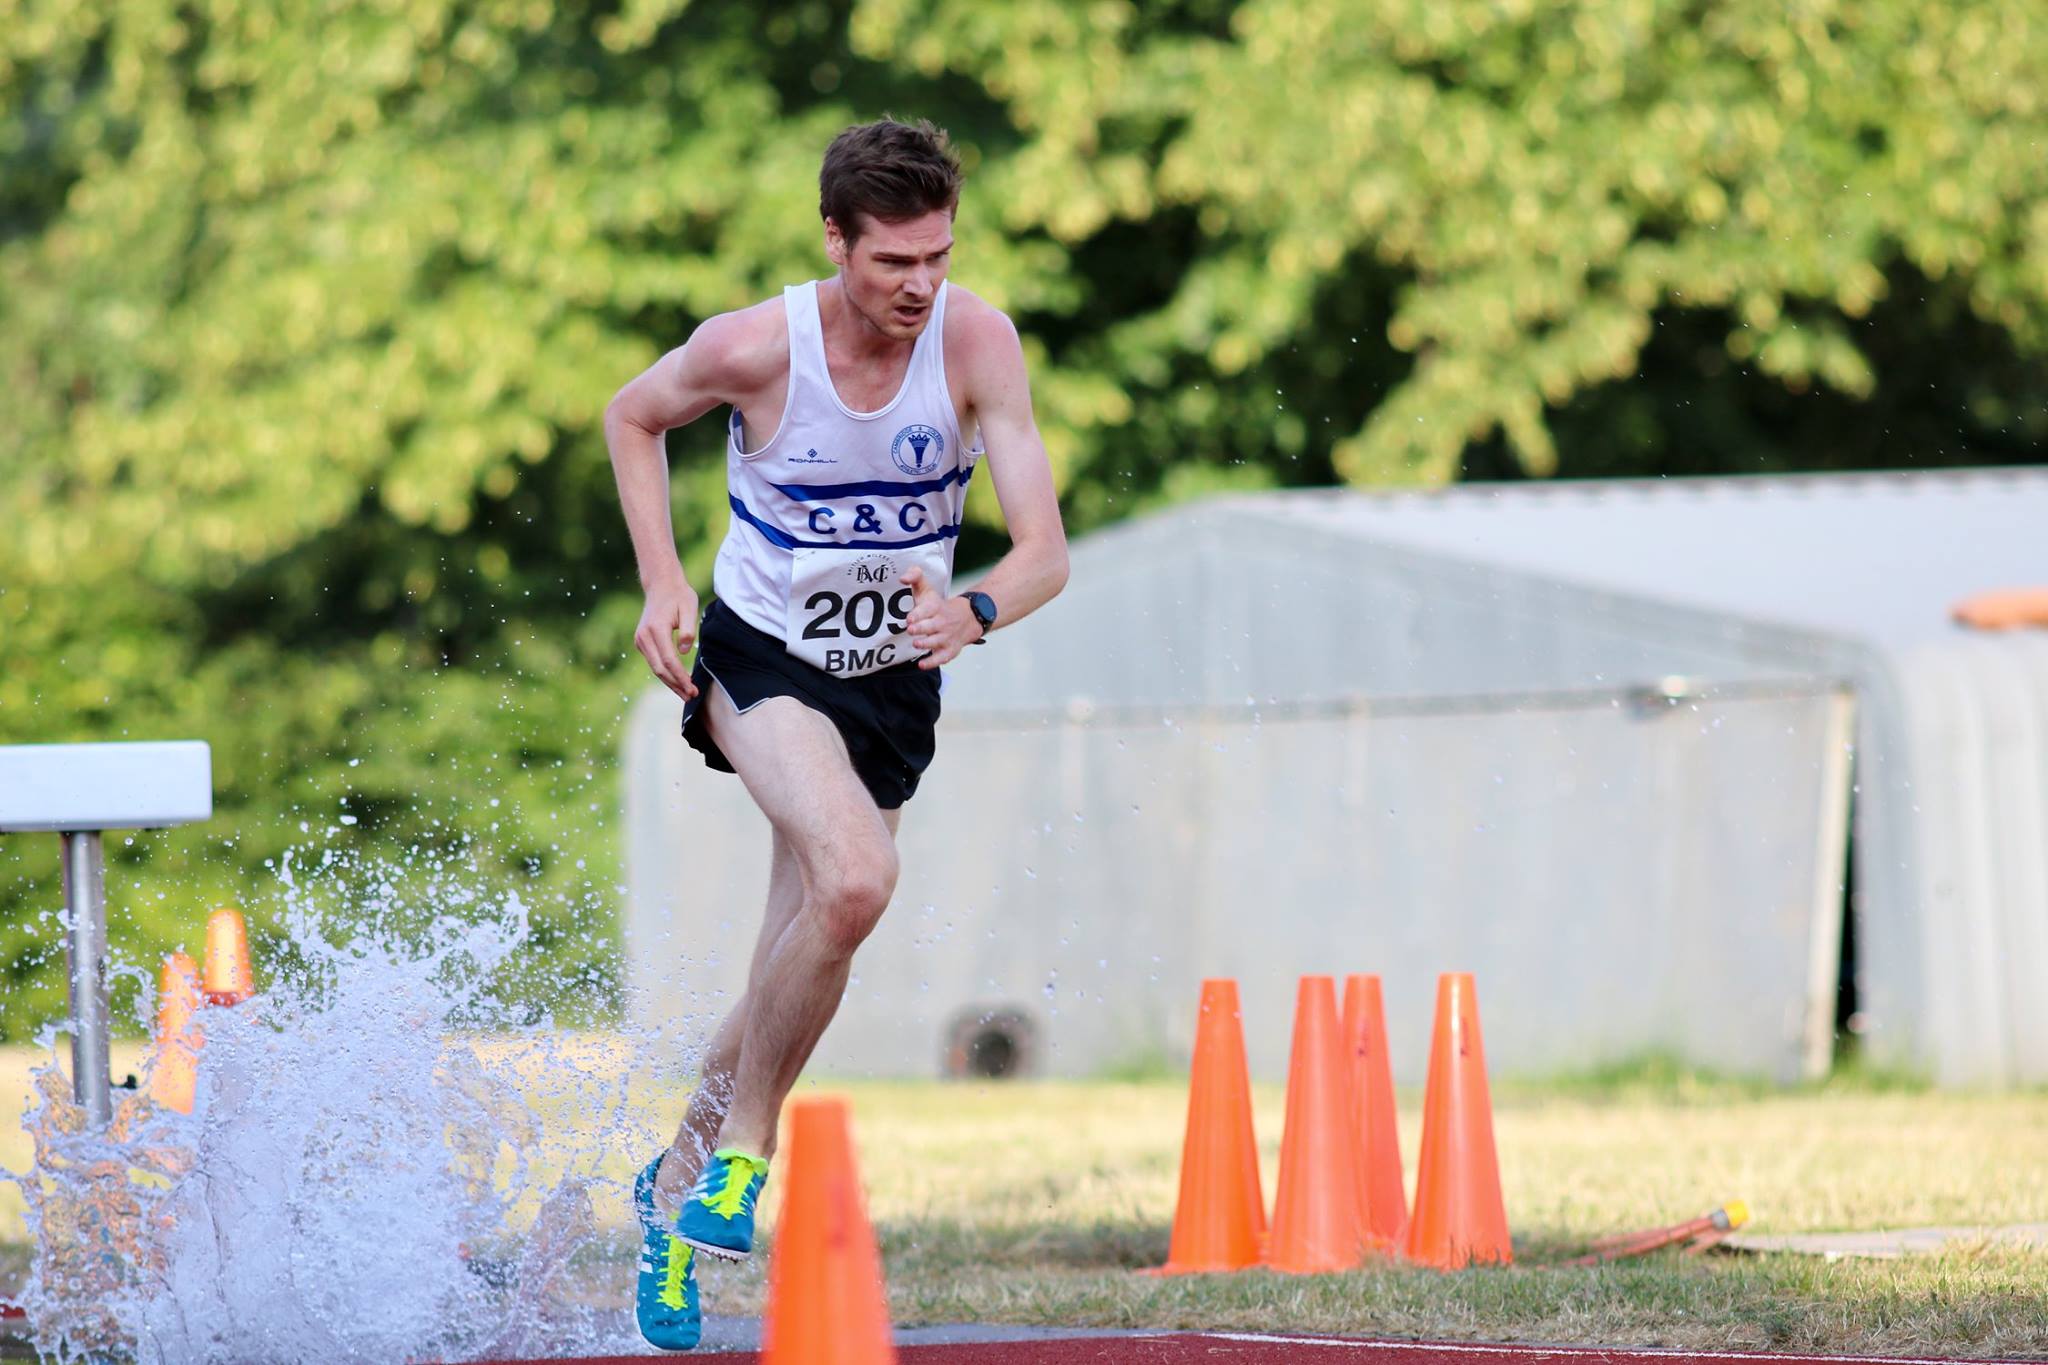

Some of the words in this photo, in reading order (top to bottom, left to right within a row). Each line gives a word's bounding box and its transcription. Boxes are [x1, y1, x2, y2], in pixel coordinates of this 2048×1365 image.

[808, 506, 837, 535] C
[853, 503, 883, 535] &
[898, 502, 927, 532] C
[825, 643, 896, 673] BMC
